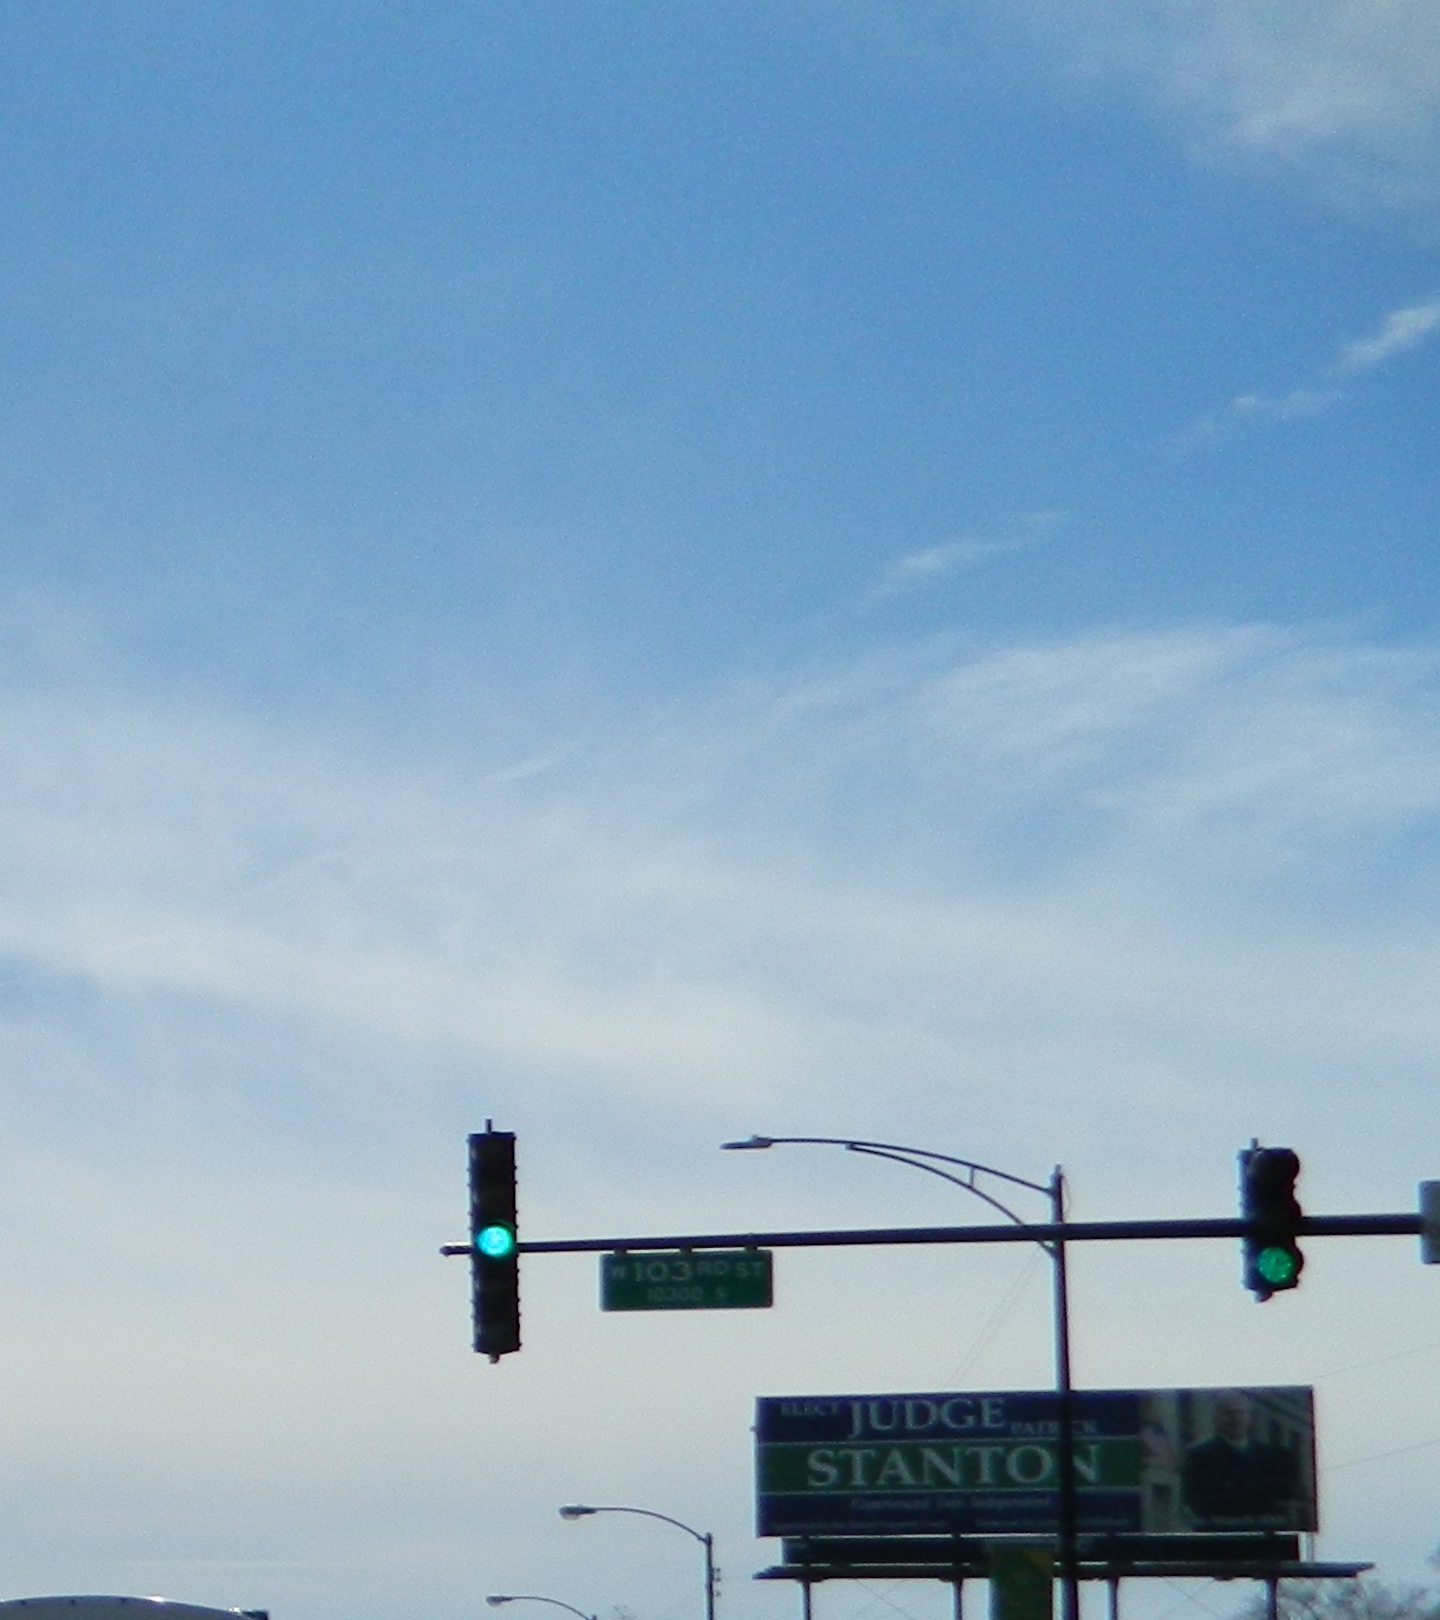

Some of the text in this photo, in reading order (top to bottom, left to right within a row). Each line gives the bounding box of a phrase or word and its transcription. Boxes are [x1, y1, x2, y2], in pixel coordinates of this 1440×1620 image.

[734, 1261, 765, 1279] ST
[646, 1285, 704, 1302] 10300
[780, 1401, 839, 1417] ELECT
[847, 1398, 1005, 1439] JUDGE
[1010, 1420, 1097, 1436] PATRCK
[806, 1446, 1102, 1487] STANTON
